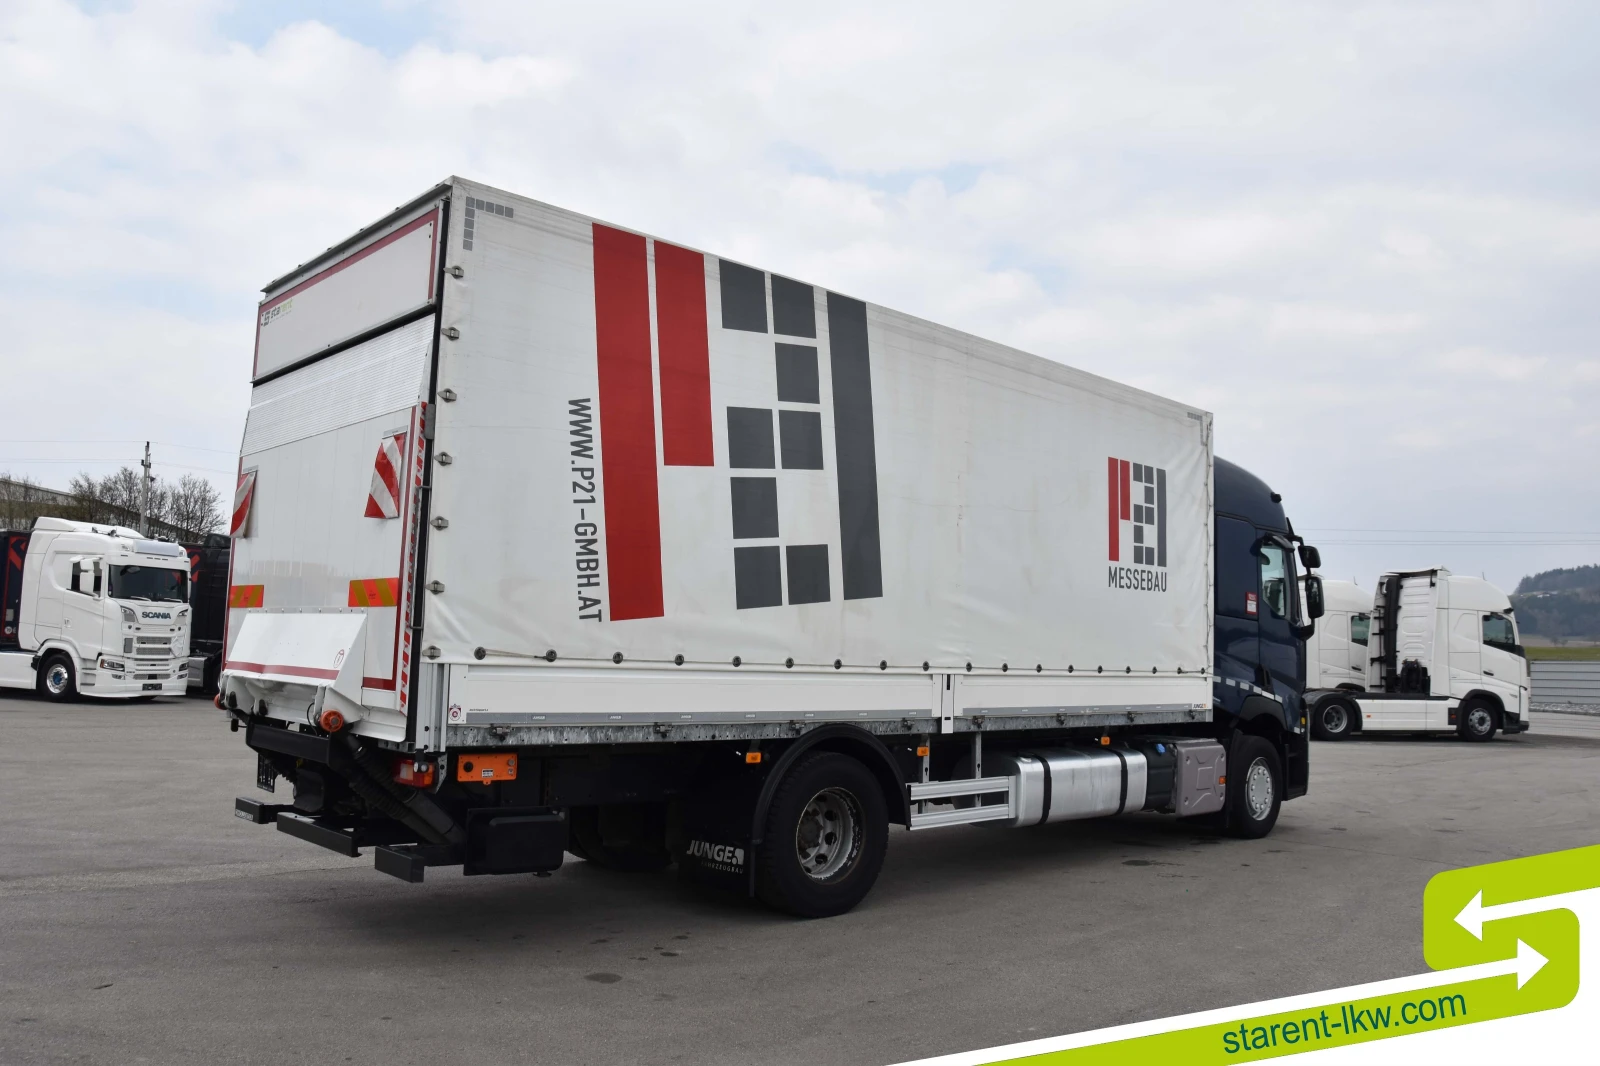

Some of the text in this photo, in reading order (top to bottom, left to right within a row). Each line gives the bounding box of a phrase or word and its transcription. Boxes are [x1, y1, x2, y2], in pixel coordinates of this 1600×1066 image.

[568, 398, 602, 622] WWW.P21-GMBH.AT
[1108, 565, 1167, 592] MESSEBAU
[141, 611, 172, 619] SCANIA
[686, 840, 735, 863] JUNGE
